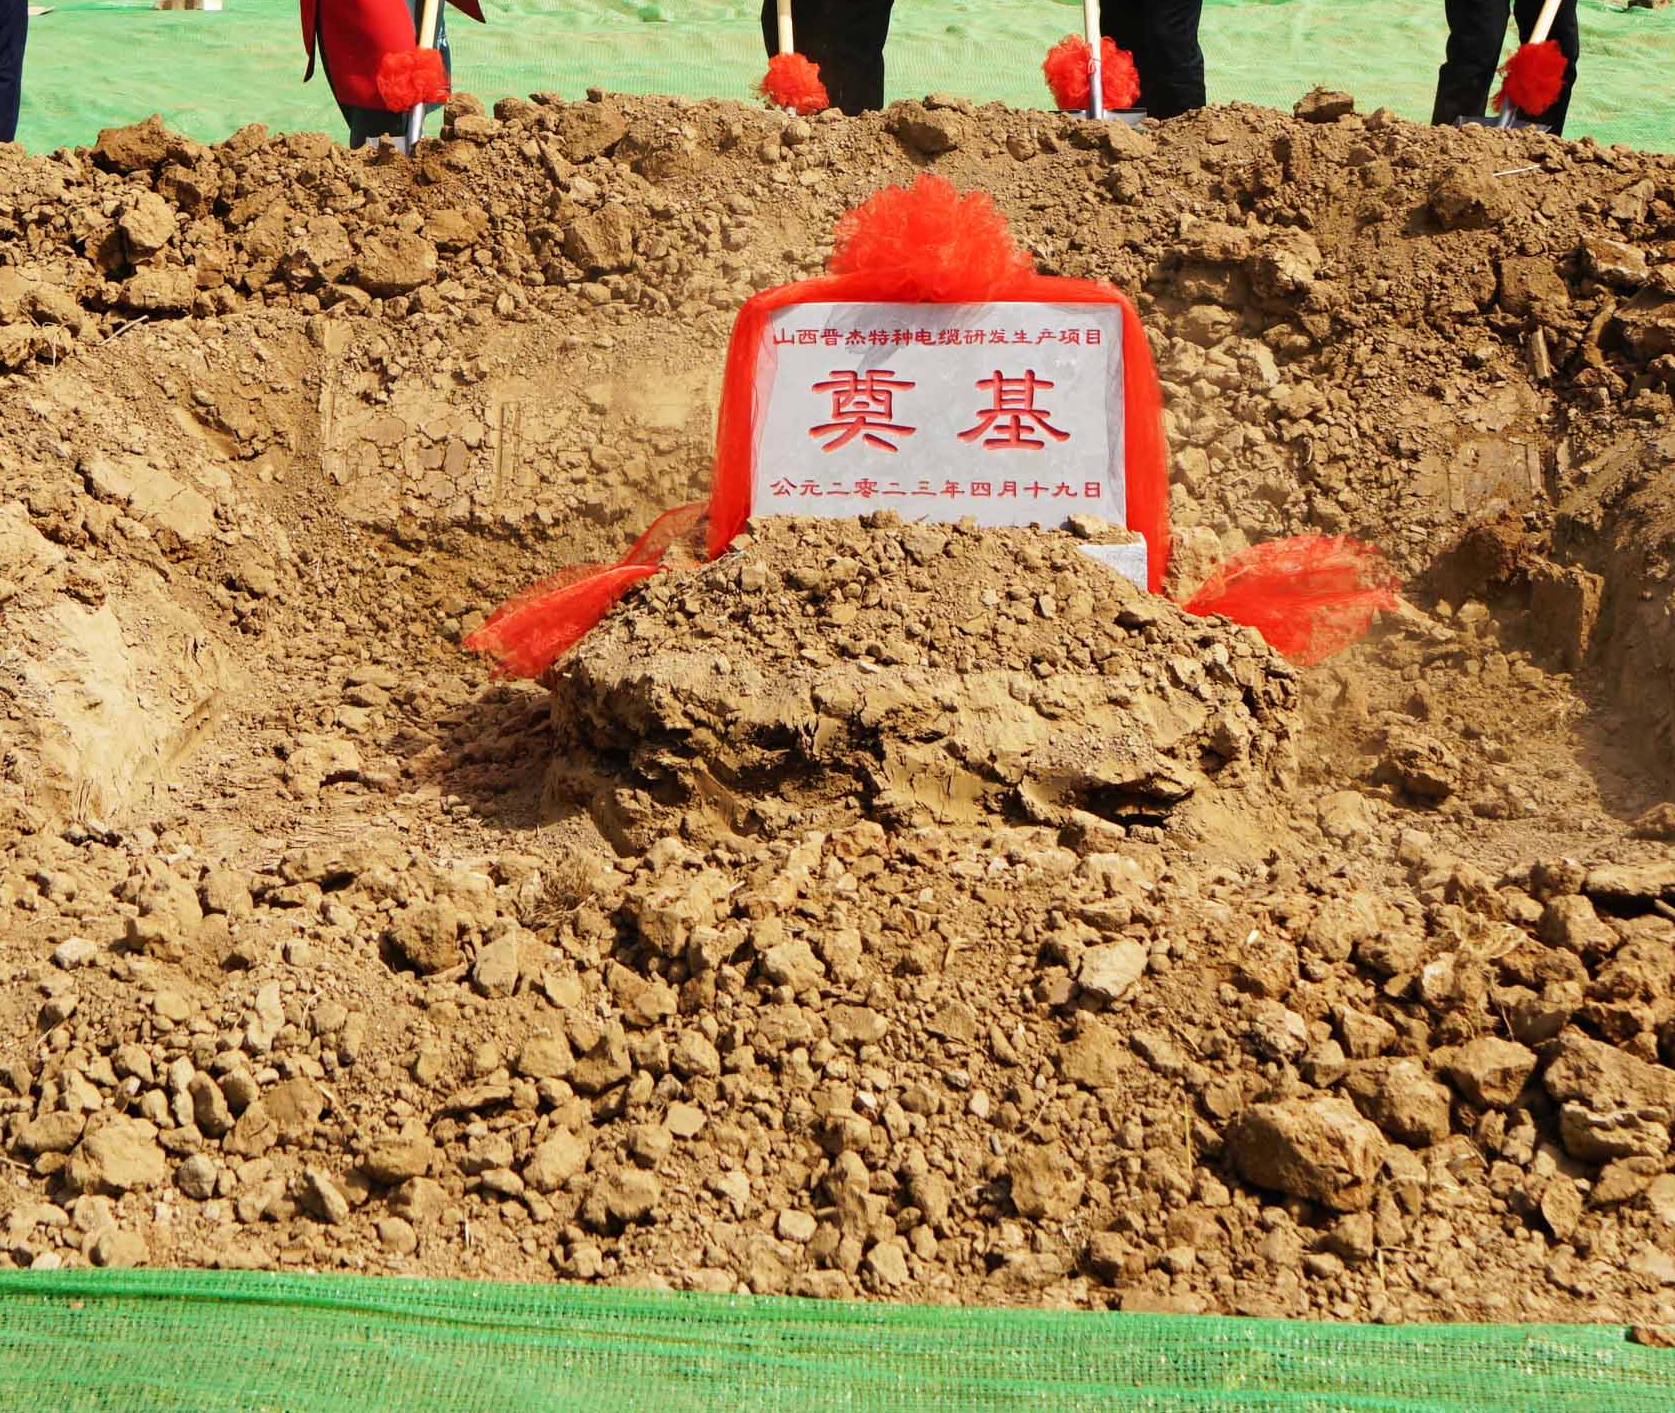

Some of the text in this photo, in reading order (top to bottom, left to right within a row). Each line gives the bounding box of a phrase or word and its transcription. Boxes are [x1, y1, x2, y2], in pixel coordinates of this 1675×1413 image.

[771, 327, 1102, 347] 山西晋杰特种电缆研发生产项目
[808, 369, 1071, 452] 奠基
[769, 477, 1102, 500] 公元二零二三年四月十九日
